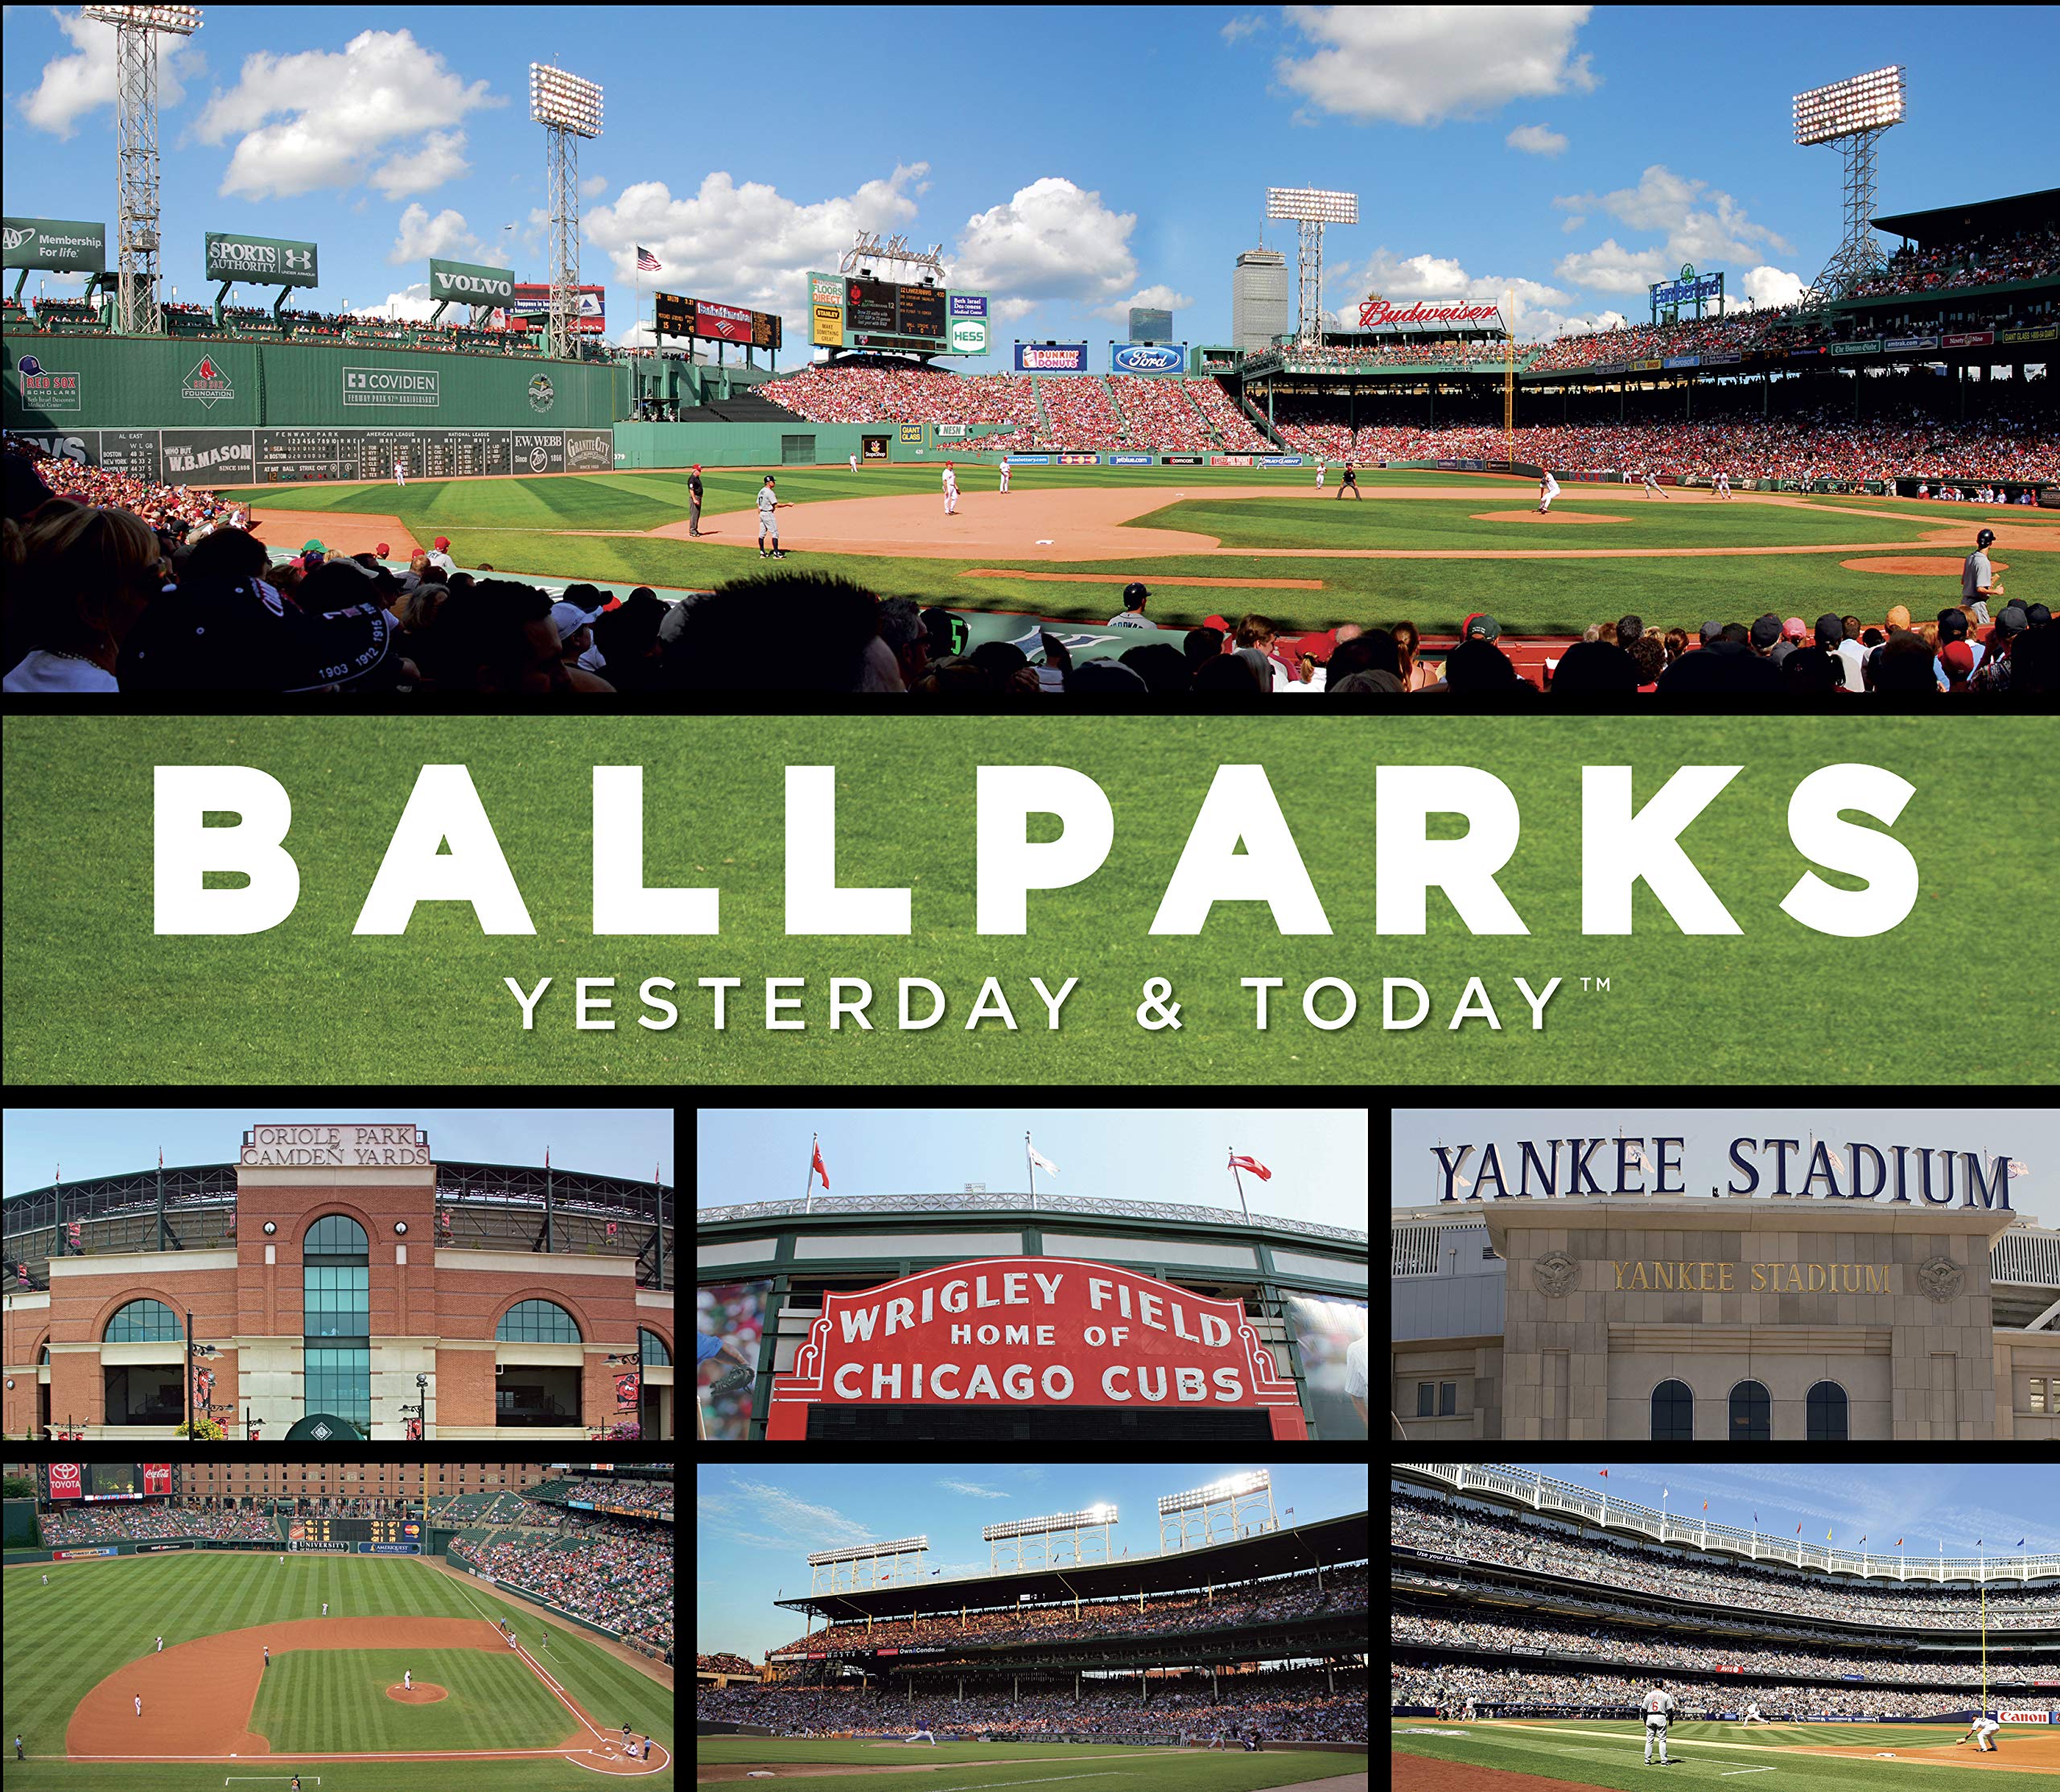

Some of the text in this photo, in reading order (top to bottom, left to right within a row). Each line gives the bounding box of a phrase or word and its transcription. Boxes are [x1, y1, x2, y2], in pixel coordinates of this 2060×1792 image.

[39, 247, 57, 257] For
[210, 241, 275, 263] SPORTS
[840, 229, 884, 273] John
[211, 258, 274, 273] AUTHORITY
[435, 272, 512, 296] VOLVO
[813, 285, 843, 295] FLOORS
[813, 293, 841, 304] DIRECT
[698, 302, 751, 323] Bank of America
[817, 309, 838, 318] STANLEY
[1359, 300, 1498, 327] Budweiser
[663, 321, 669, 329] 15
[954, 332, 983, 341] HESS
[1950, 336, 1963, 344] Ninety
[2004, 332, 2017, 341] GIANT
[2017, 332, 2030, 340] GLASS
[1844, 344, 1862, 352] Boston
[1862, 344, 1877, 352] Globe
[1887, 340, 1918, 348] amtrak.com
[1038, 350, 1079, 360] DUNKIN'
[1129, 349, 1167, 368] Ford
[1038, 359, 1078, 368] DONUTS
[1669, 357, 1695, 366] Microsoft
[27, 377, 76, 389] RED SOX
[369, 375, 435, 389] COVIDIEN
[348, 394, 370, 402] FENWAY
[943, 426, 961, 435] NESN
[515, 435, 562, 447] F.W. WEBB
[164, 447, 192, 455] WHO BUT
[567, 436, 610, 458] GRANITE CITY
[515, 455, 527, 463] Since
[269, 472, 277, 481] 12
[371, 620, 384, 642] 1915
[950, 619, 963, 655] 5
[356, 647, 379, 666] 1912
[319, 664, 348, 678] 1903
[259, 1128, 412, 1145] ORIOLE PARK
[329, 1143, 340, 1151] at
[243, 1148, 426, 1165] CAMDEN YARDS
[1430, 1137, 2015, 1213] YANKEE STADIUM
[1611, 1261, 1892, 1294] YANKEE STADIUM
[839, 1272, 1232, 1349] WRIGLEY FIELD
[950, 1324, 1130, 1348] HOME OF
[833, 1362, 1244, 1403] CHICAGO CUBS
[51, 1481, 81, 1489] TOYOTA
[1444, 1555, 1469, 1565] MasterC
[1652, 1701, 1658, 1711] 6
[2000, 1712, 2047, 1723] Canon
